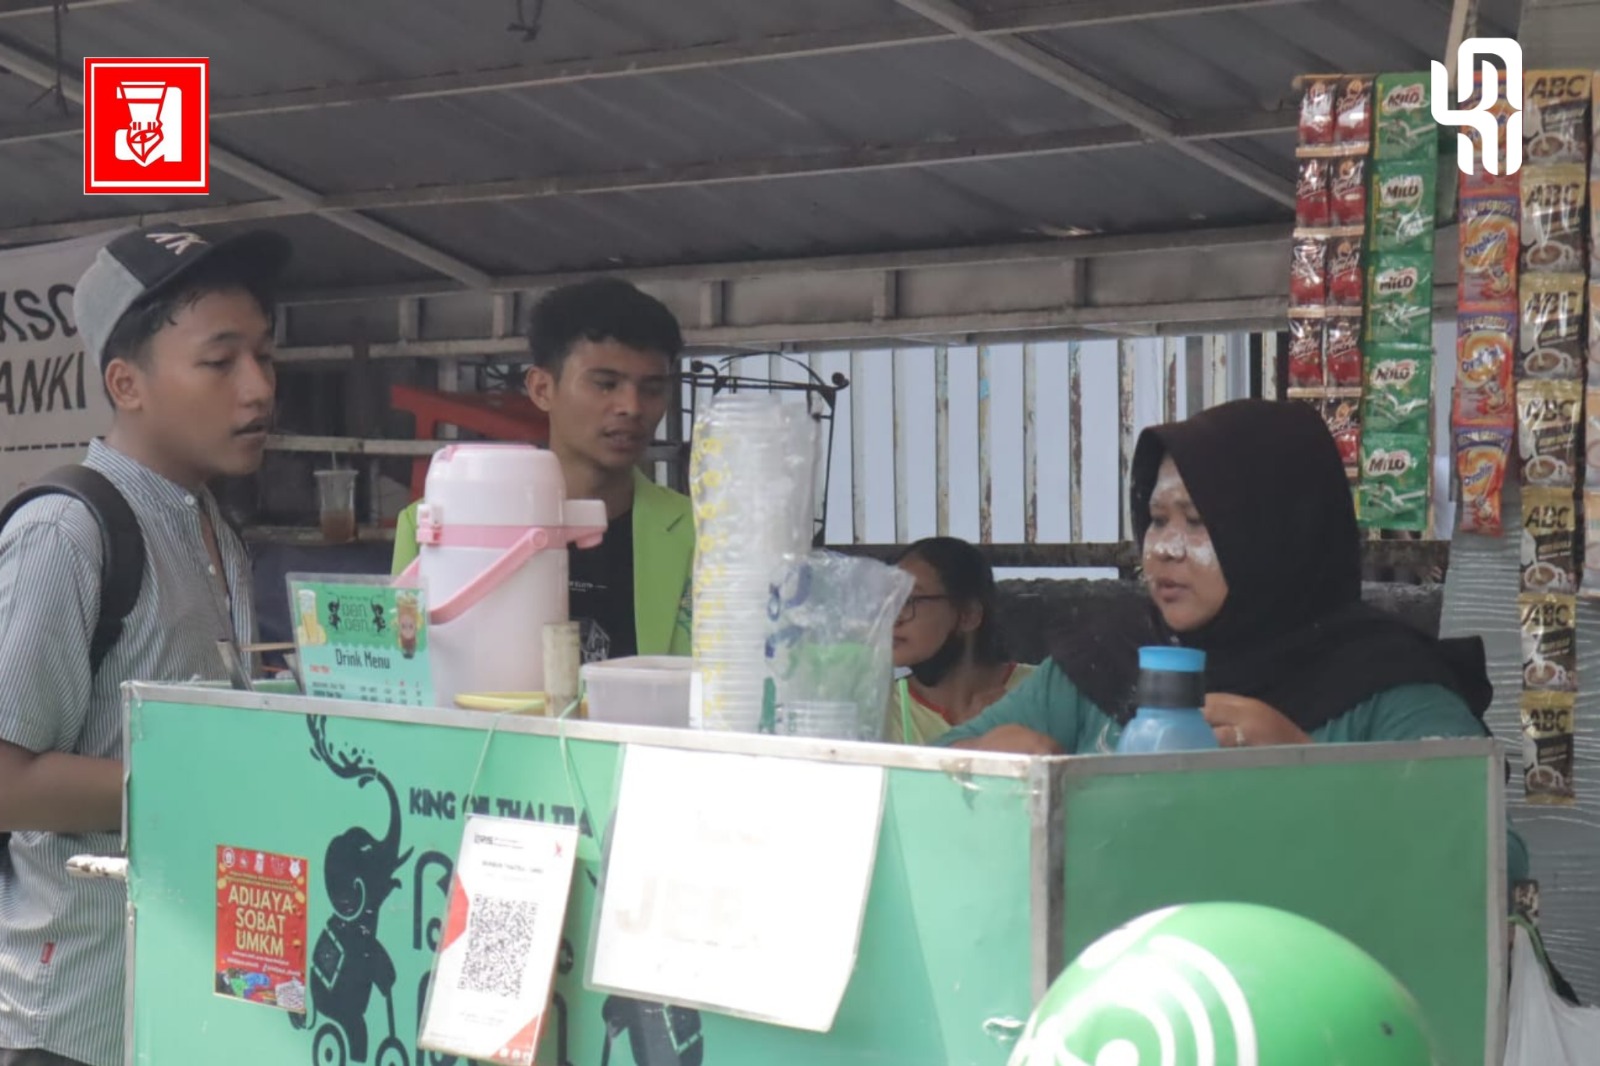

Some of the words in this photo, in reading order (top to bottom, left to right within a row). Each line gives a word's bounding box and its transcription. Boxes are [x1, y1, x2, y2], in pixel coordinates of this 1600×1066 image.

[1529, 76, 1586, 99] ABC
[1525, 182, 1581, 208] ABC
[1369, 457, 1406, 472] MILO
[1525, 506, 1570, 529] ABC
[1529, 603, 1569, 627] ABC
[335, 648, 363, 667] Drink
[364, 651, 391, 669] Menu
[1529, 709, 1568, 732] ABC
[409, 787, 457, 820] KING
[228, 885, 293, 914] ADIJAYA
[235, 907, 286, 934] SOBAT
[236, 929, 284, 957] UMKM
